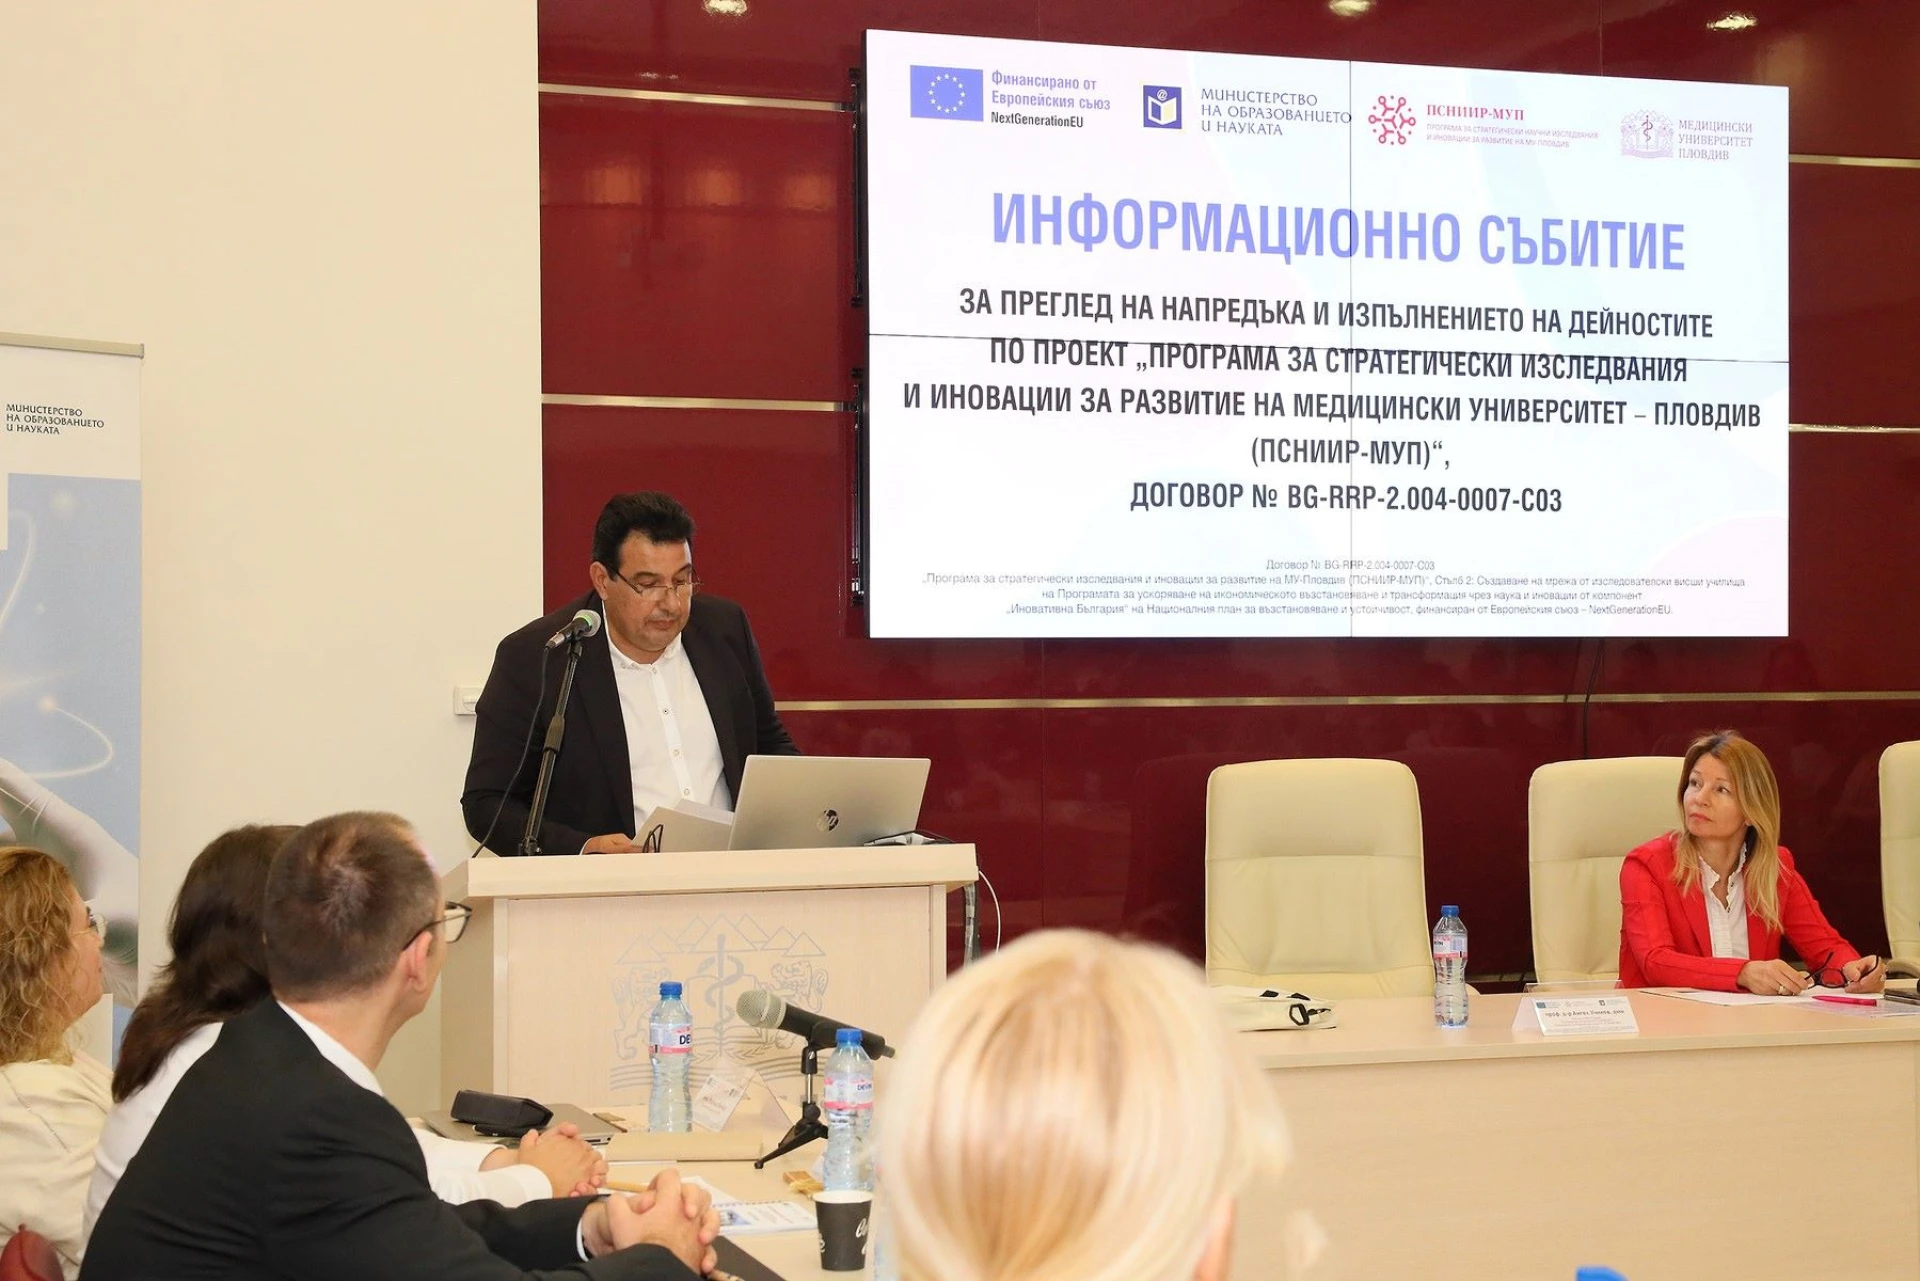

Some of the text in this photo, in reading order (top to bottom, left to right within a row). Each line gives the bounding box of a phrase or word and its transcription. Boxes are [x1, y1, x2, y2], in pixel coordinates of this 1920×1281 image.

[992, 70, 1096, 90] Финансирано от
[992, 90, 1110, 110] Европейския съюз
[1201, 88, 1317, 106] МИНИСТЕРСТВО
[991, 111, 1083, 127] NextGenerationEU
[1201, 104, 1352, 125] НА ОБРАЗОВАНИЕТО
[1427, 104, 1523, 120] ПСНИИР-МУП
[1202, 120, 1282, 136] И НАУКАТА
[1679, 120, 1752, 133] МЕДИЦИНСКИ
[1678, 133, 1753, 147] УНИВЕРСИТЕТ
[1678, 147, 1729, 161] ПЛОВДИВ
[992, 192, 1684, 270] ИНФОРМАЦИОННО СЪБИТИЕ
[960, 288, 1712, 338] ЗА ПРЕГЛЕД НА НАПРЕДЪКА И ИЗПЪЛНЕНИЕТО НА ДЕЙНОСТИТЕ
[990, 338, 1024, 364] ПО
[1033, 342, 1129, 367] ПРОЕКТ
[1287, 347, 1318, 372] ЗА
[1326, 348, 1512, 378] СТРАТЕГИЧЕСКИ
[1521, 354, 1687, 384] ИЗСЛЕДВАНИЯ
[6, 404, 82, 417] МИНИСТЕРСТВО
[904, 383, 920, 408] И
[931, 384, 1071, 416] ИНОВАЦИИ
[1080, 387, 1111, 413] ЗА
[1121, 388, 1245, 416] РАЗВИТИЕ
[1254, 392, 1285, 416] НА
[1294, 393, 1460, 424] МЕДИЦИНСКИ
[1468, 397, 1627, 424] УНИВЕРСИТЕТ
[1655, 402, 1760, 431] ПЛОВДИВ
[6, 413, 104, 428] НА ОБРАЗОВАНИЕТО
[6, 423, 59, 434] И НАУКАТА
[1130, 482, 1561, 512] ДОГОВОР № BG-RRP-2.004-0007-C03
[1042, 590, 1054, 598] на
[1057, 588, 1120, 600] Програмата
[1123, 590, 1135, 599] за
[1137, 590, 1196, 601] ускоряване
[1198, 590, 1211, 599] на
[1213, 591, 1297, 599] икономическото
[1299, 590, 1378, 600] възстановяване
[1389, 590, 1466, 601] трансформация
[1468, 592, 1491, 601] чрез
[1494, 592, 1521, 601] наука
[1532, 592, 1577, 600] иновации
[1579, 591, 1590, 600] от
[1592, 592, 1642, 600] компонент
[1131, 605, 1144, 614] на
[1146, 604, 1215, 614] Националния
[1217, 606, 1242, 614] план
[1244, 606, 1256, 614] за
[1258, 605, 1338, 614] възстановяване
[1415, 605, 1475, 615] финансиран
[1477, 606, 1488, 614] от
[1490, 603, 1552, 616] Европейския
[1554, 606, 1579, 614] съюз
